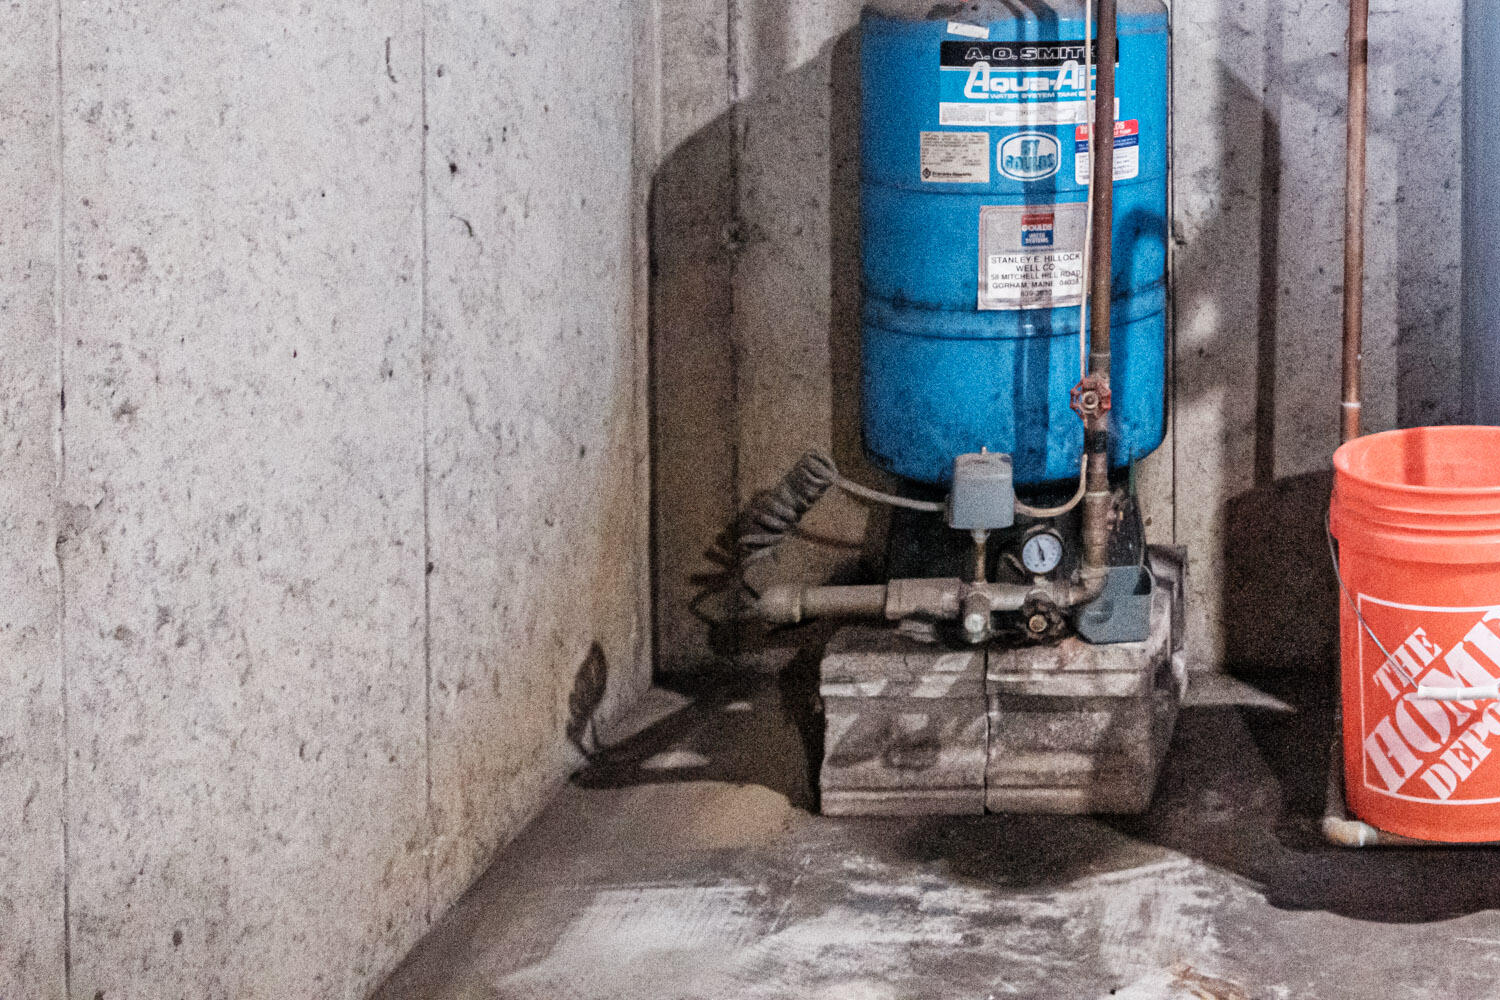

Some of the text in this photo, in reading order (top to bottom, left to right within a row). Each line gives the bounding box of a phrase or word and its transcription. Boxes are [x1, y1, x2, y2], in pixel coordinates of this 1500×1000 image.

[1005, 152, 1055, 173] GOULDS
[1021, 223, 1053, 232] GOULDS
[991, 255, 1031, 264] STANLEY
[1044, 253, 1080, 263] HILLOCK
[1016, 264, 1040, 272] WELL
[1001, 272, 1040, 281] MITCHELL
[1041, 271, 1058, 279] HILL
[1373, 627, 1443, 700] THE
